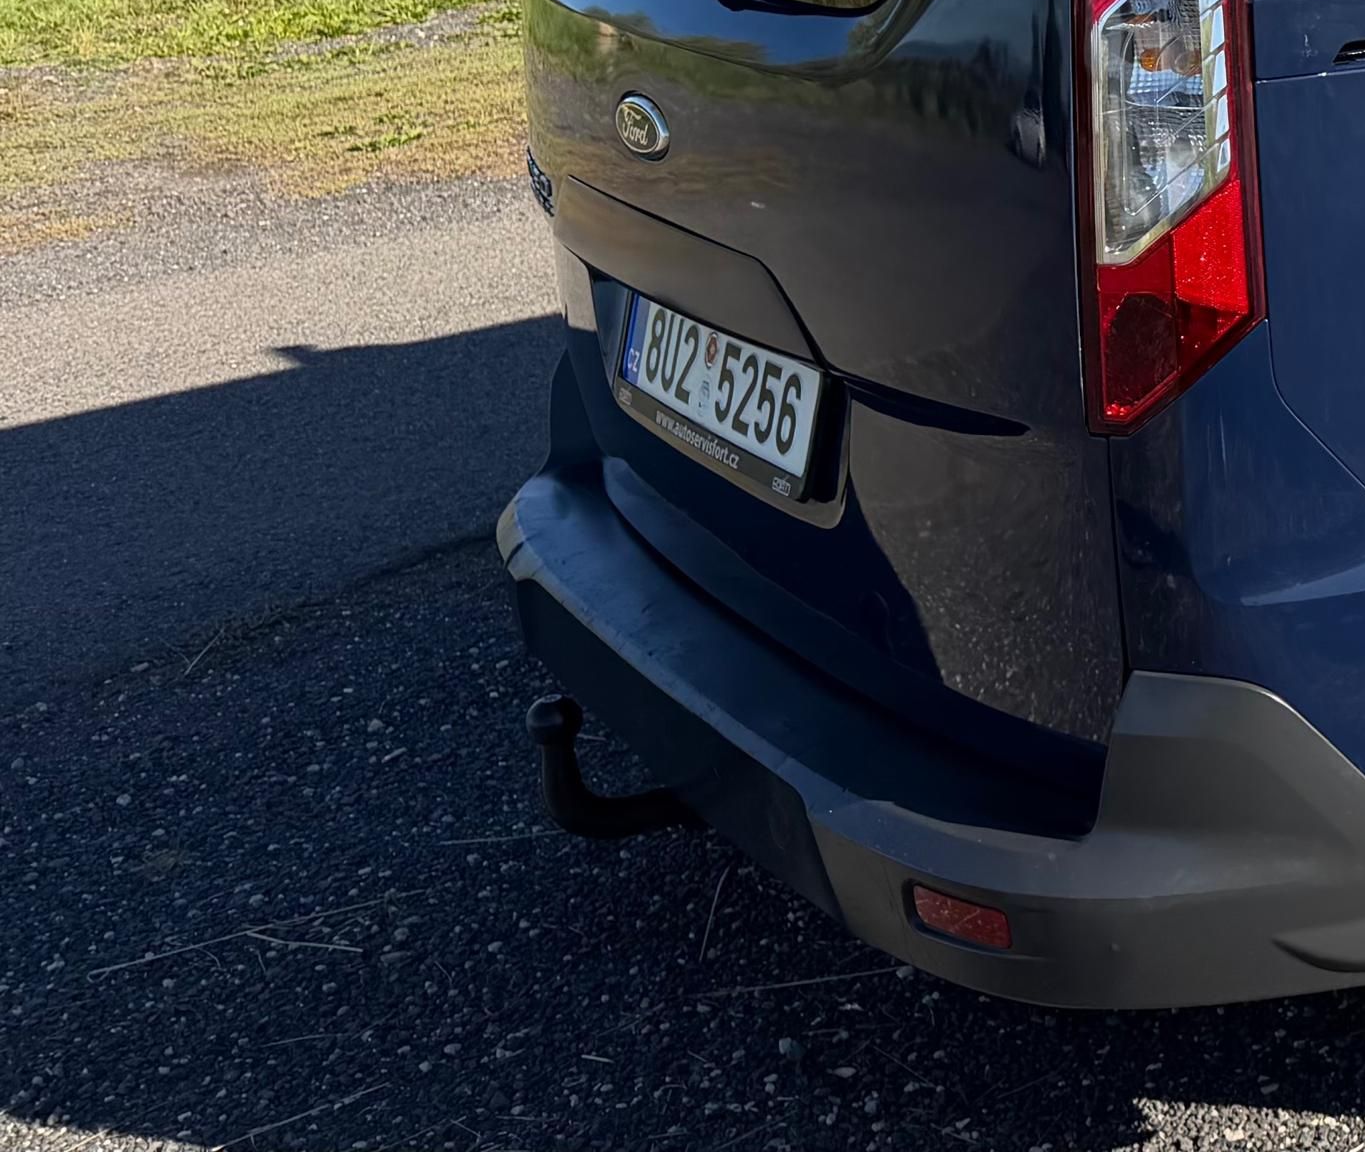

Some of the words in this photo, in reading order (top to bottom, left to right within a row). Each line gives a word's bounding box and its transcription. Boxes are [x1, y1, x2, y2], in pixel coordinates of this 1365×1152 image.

[622, 105, 649, 146] Ford
[627, 348, 640, 373] CZ
[645, 308, 699, 405] 8U2
[714, 342, 802, 455] 5256
[656, 410, 740, 470] www.autoservisfort.cz
